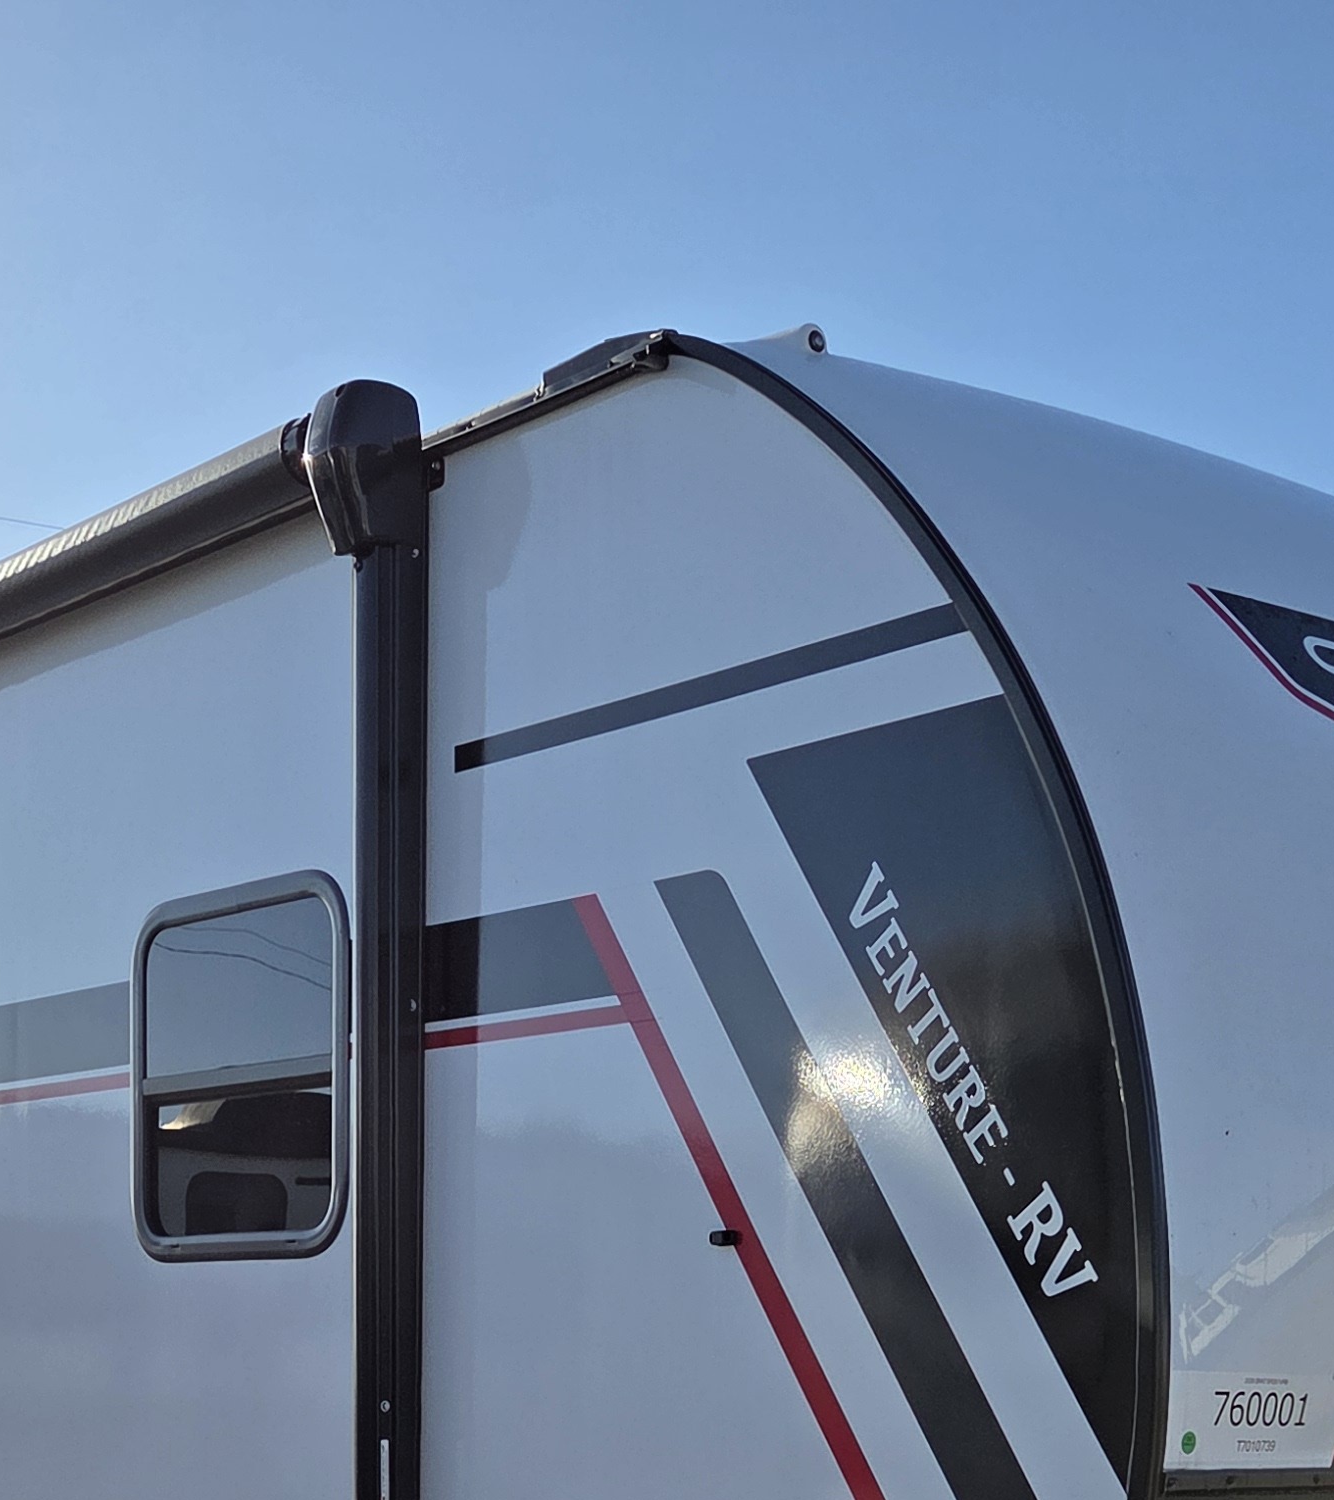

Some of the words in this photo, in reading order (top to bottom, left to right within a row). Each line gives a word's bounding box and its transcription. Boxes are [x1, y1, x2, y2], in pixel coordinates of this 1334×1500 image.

[848, 861, 1009, 1165] VENTURE
[1006, 1181, 1099, 1297] RV
[1214, 1391, 1308, 1426] 760001
